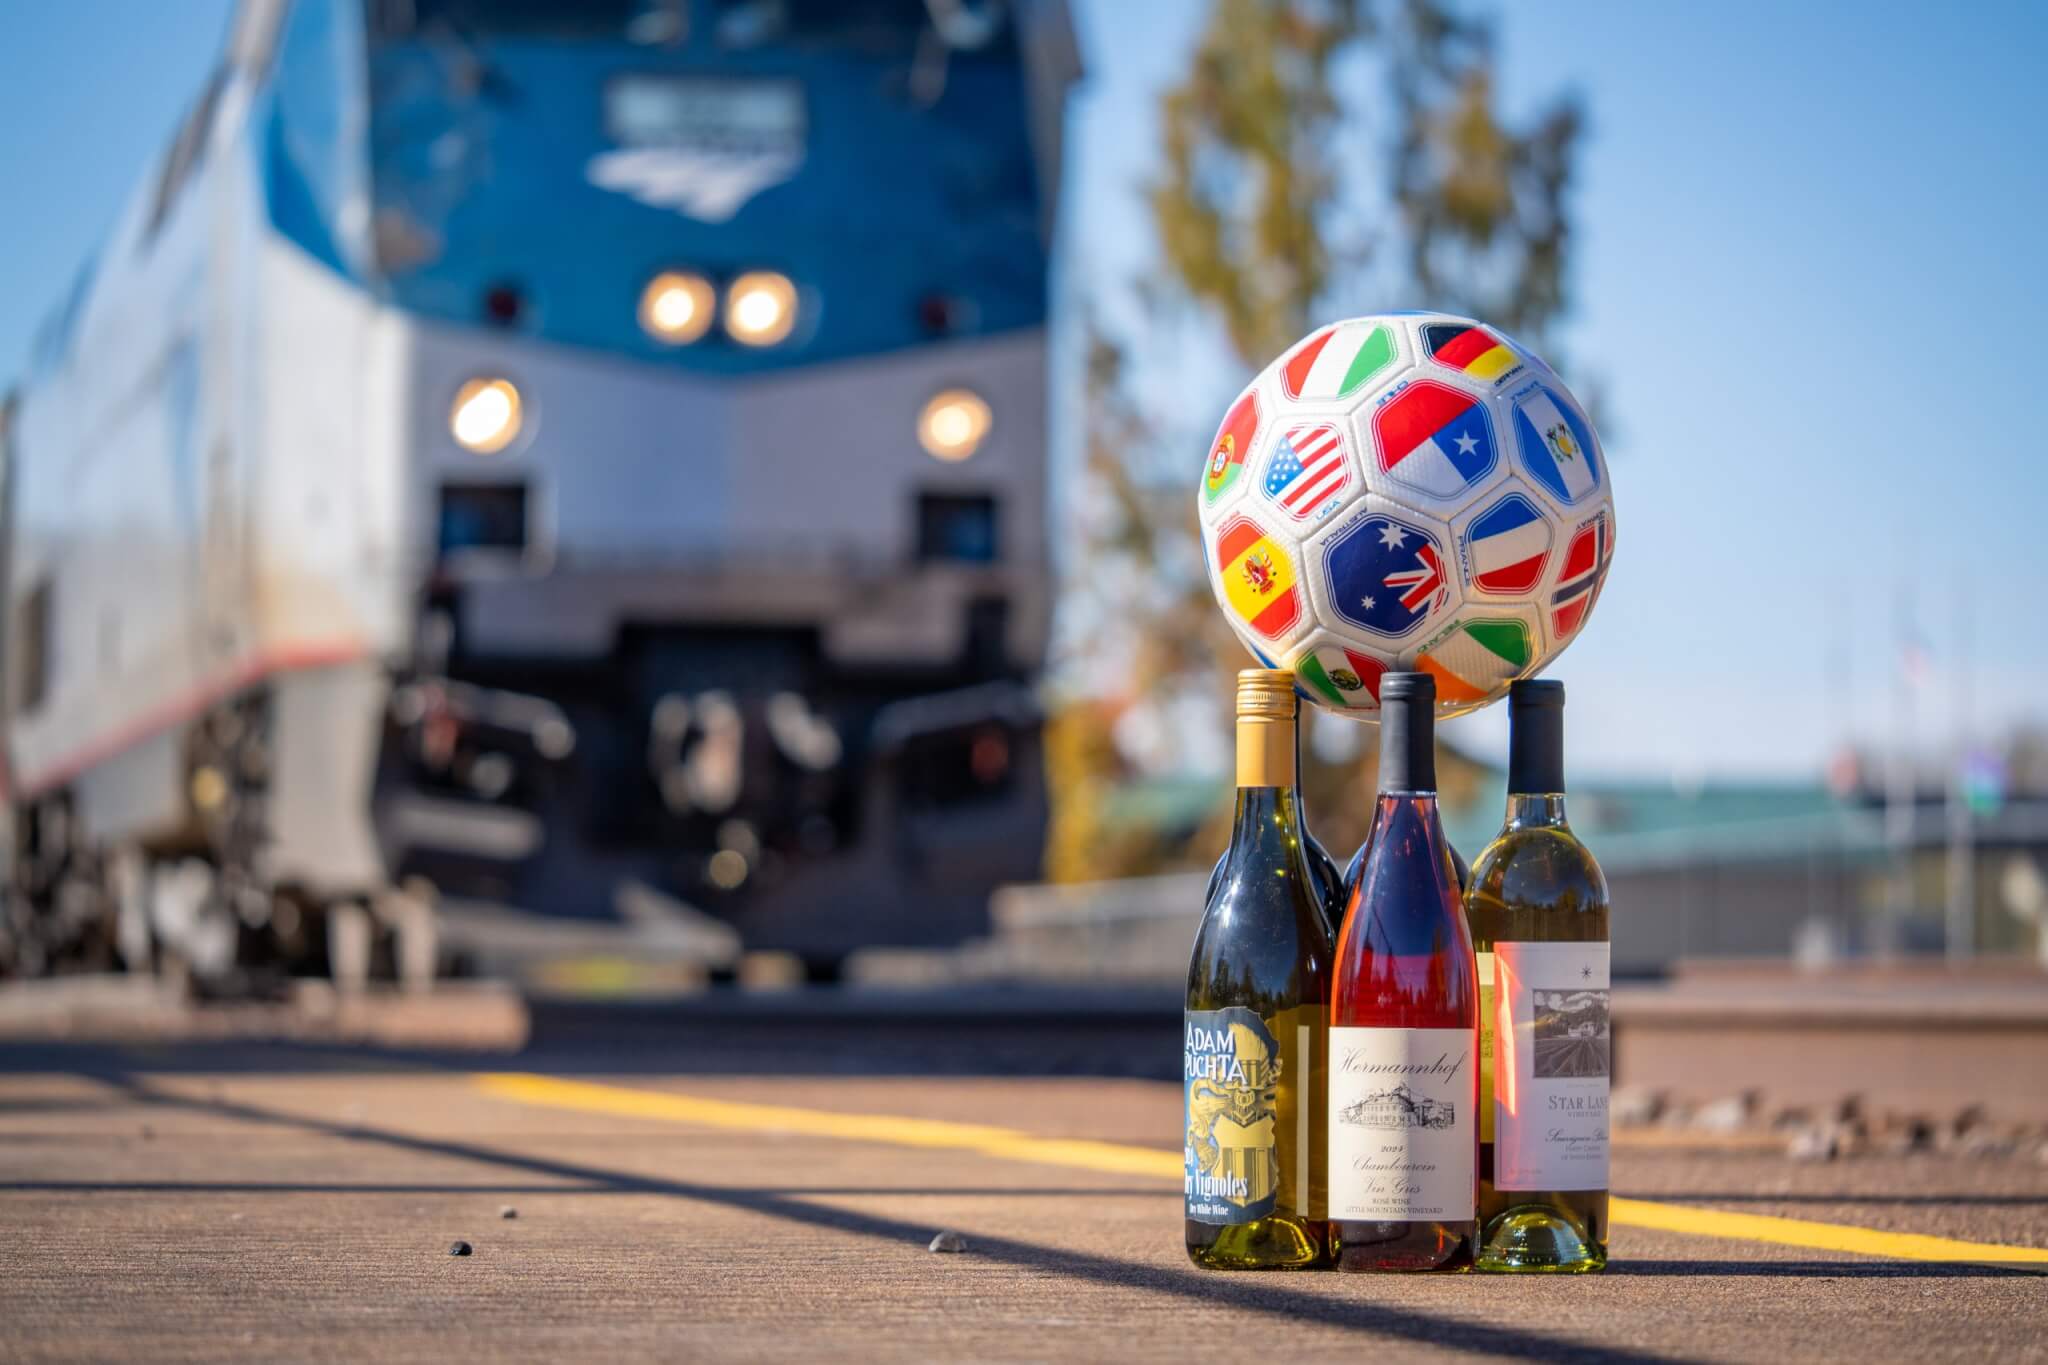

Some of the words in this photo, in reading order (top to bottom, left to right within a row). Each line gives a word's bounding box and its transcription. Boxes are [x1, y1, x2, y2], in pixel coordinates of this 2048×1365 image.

[1316, 500, 1341, 520] USA
[1319, 506, 1368, 546] AUSTRALIA
[1457, 535, 1471, 586] FRANCE
[1186, 1020, 1234, 1055] ADAM
[1184, 1051, 1248, 1085] PUCHTA
[1339, 1047, 1468, 1084] Hermannhof
[1548, 1095, 1583, 1110] STAR
[1588, 1095, 1608, 1110] LAN
[1352, 1155, 1437, 1171] Chambourcin
[1195, 1168, 1248, 1201] Vignoles
[1392, 1176, 1422, 1194] Gris
[1212, 1204, 1229, 1216] Wine
